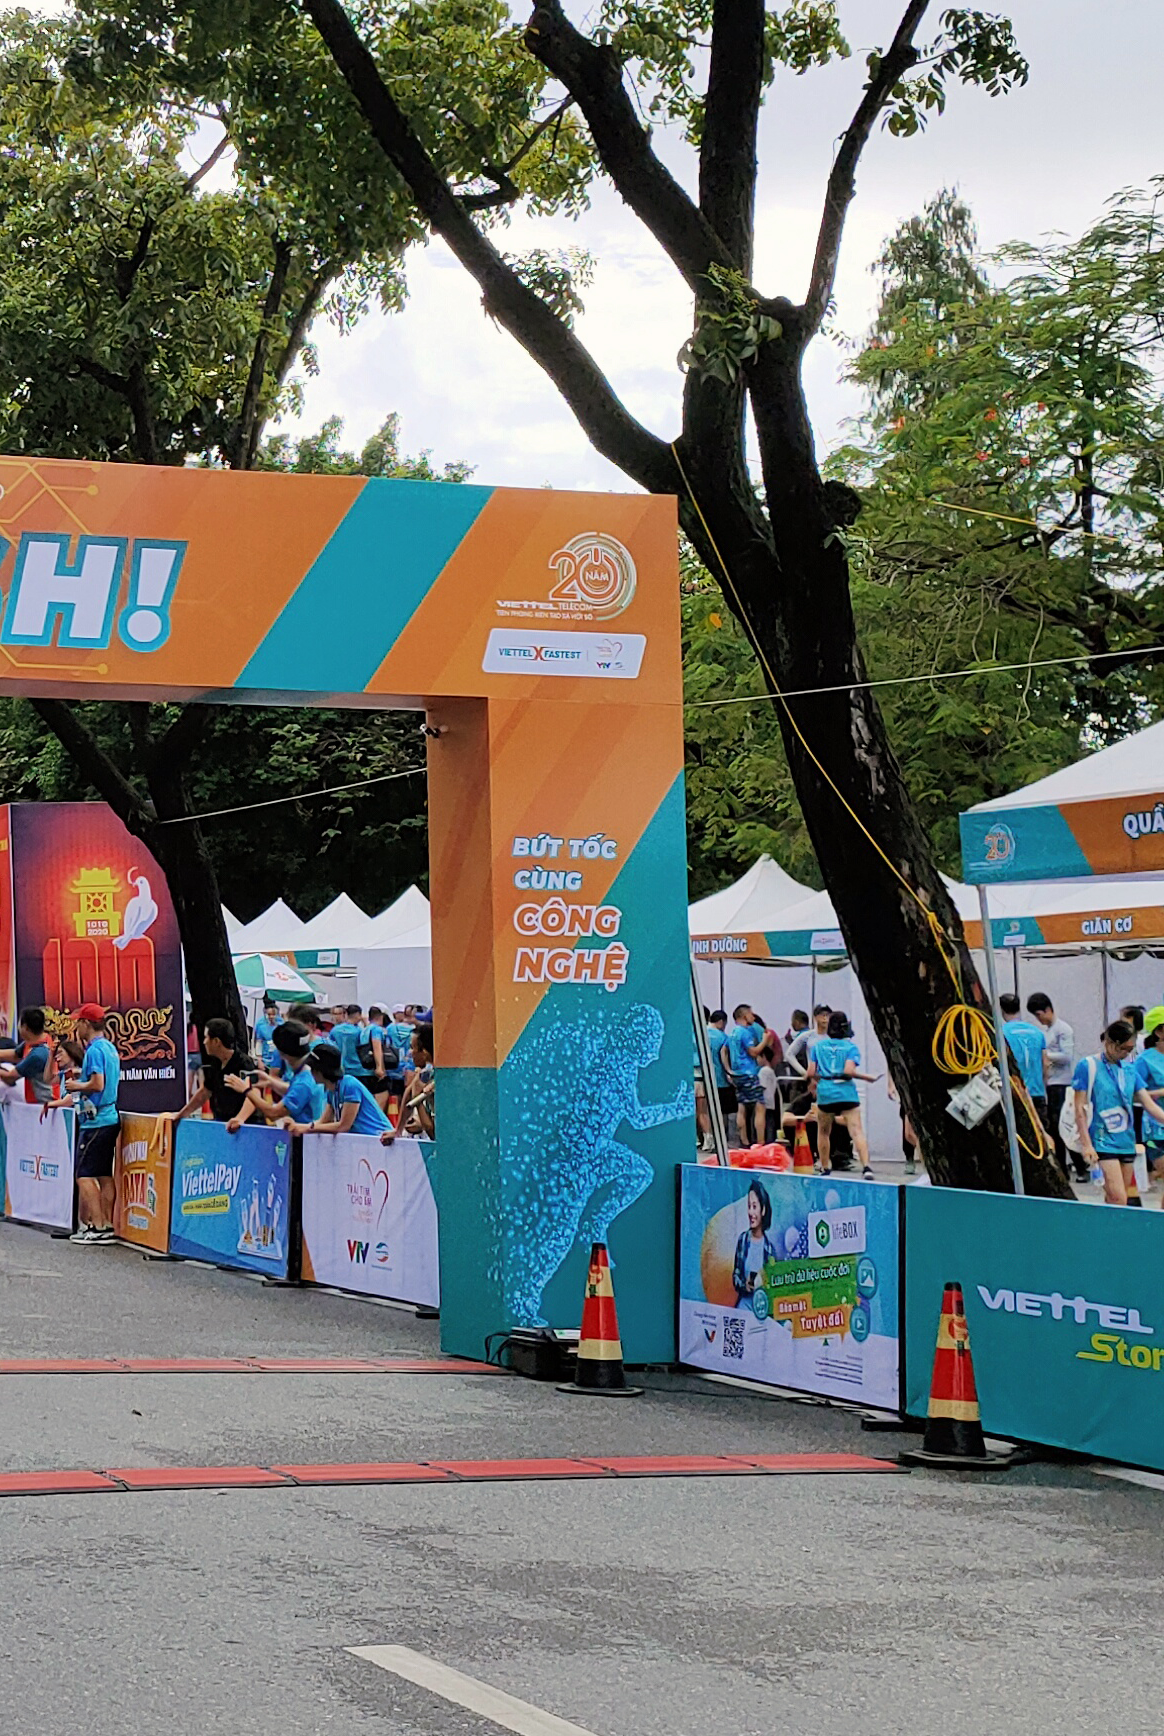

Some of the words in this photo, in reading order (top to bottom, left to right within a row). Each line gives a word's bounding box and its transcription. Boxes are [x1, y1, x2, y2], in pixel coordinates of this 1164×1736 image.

[496, 600, 558, 611] VIETTEL
[498, 647, 533, 657] VIETTEL
[544, 650, 581, 659] FASTEST
[1123, 803, 1164, 839] QUẦ
[512, 832, 564, 858] BỨT
[569, 833, 617, 859] TỐC
[513, 864, 583, 890] CÙNG
[513, 897, 622, 937] CÔNG
[1115, 915, 1133, 933] CƠ
[692, 940, 709, 954] INH
[711, 936, 747, 953] DƯỠNG
[513, 941, 629, 992] NGHỆ
[126, 1067, 142, 1081] NĂM
[143, 1066, 158, 1080] VĂN
[159, 1064, 176, 1080] HIẾN
[182, 1163, 242, 1198] ViettelPay
[347, 1239, 369, 1264] VTV
[976, 1285, 1153, 1334] VIETTEL
[1075, 1333, 1164, 1371] Stor
